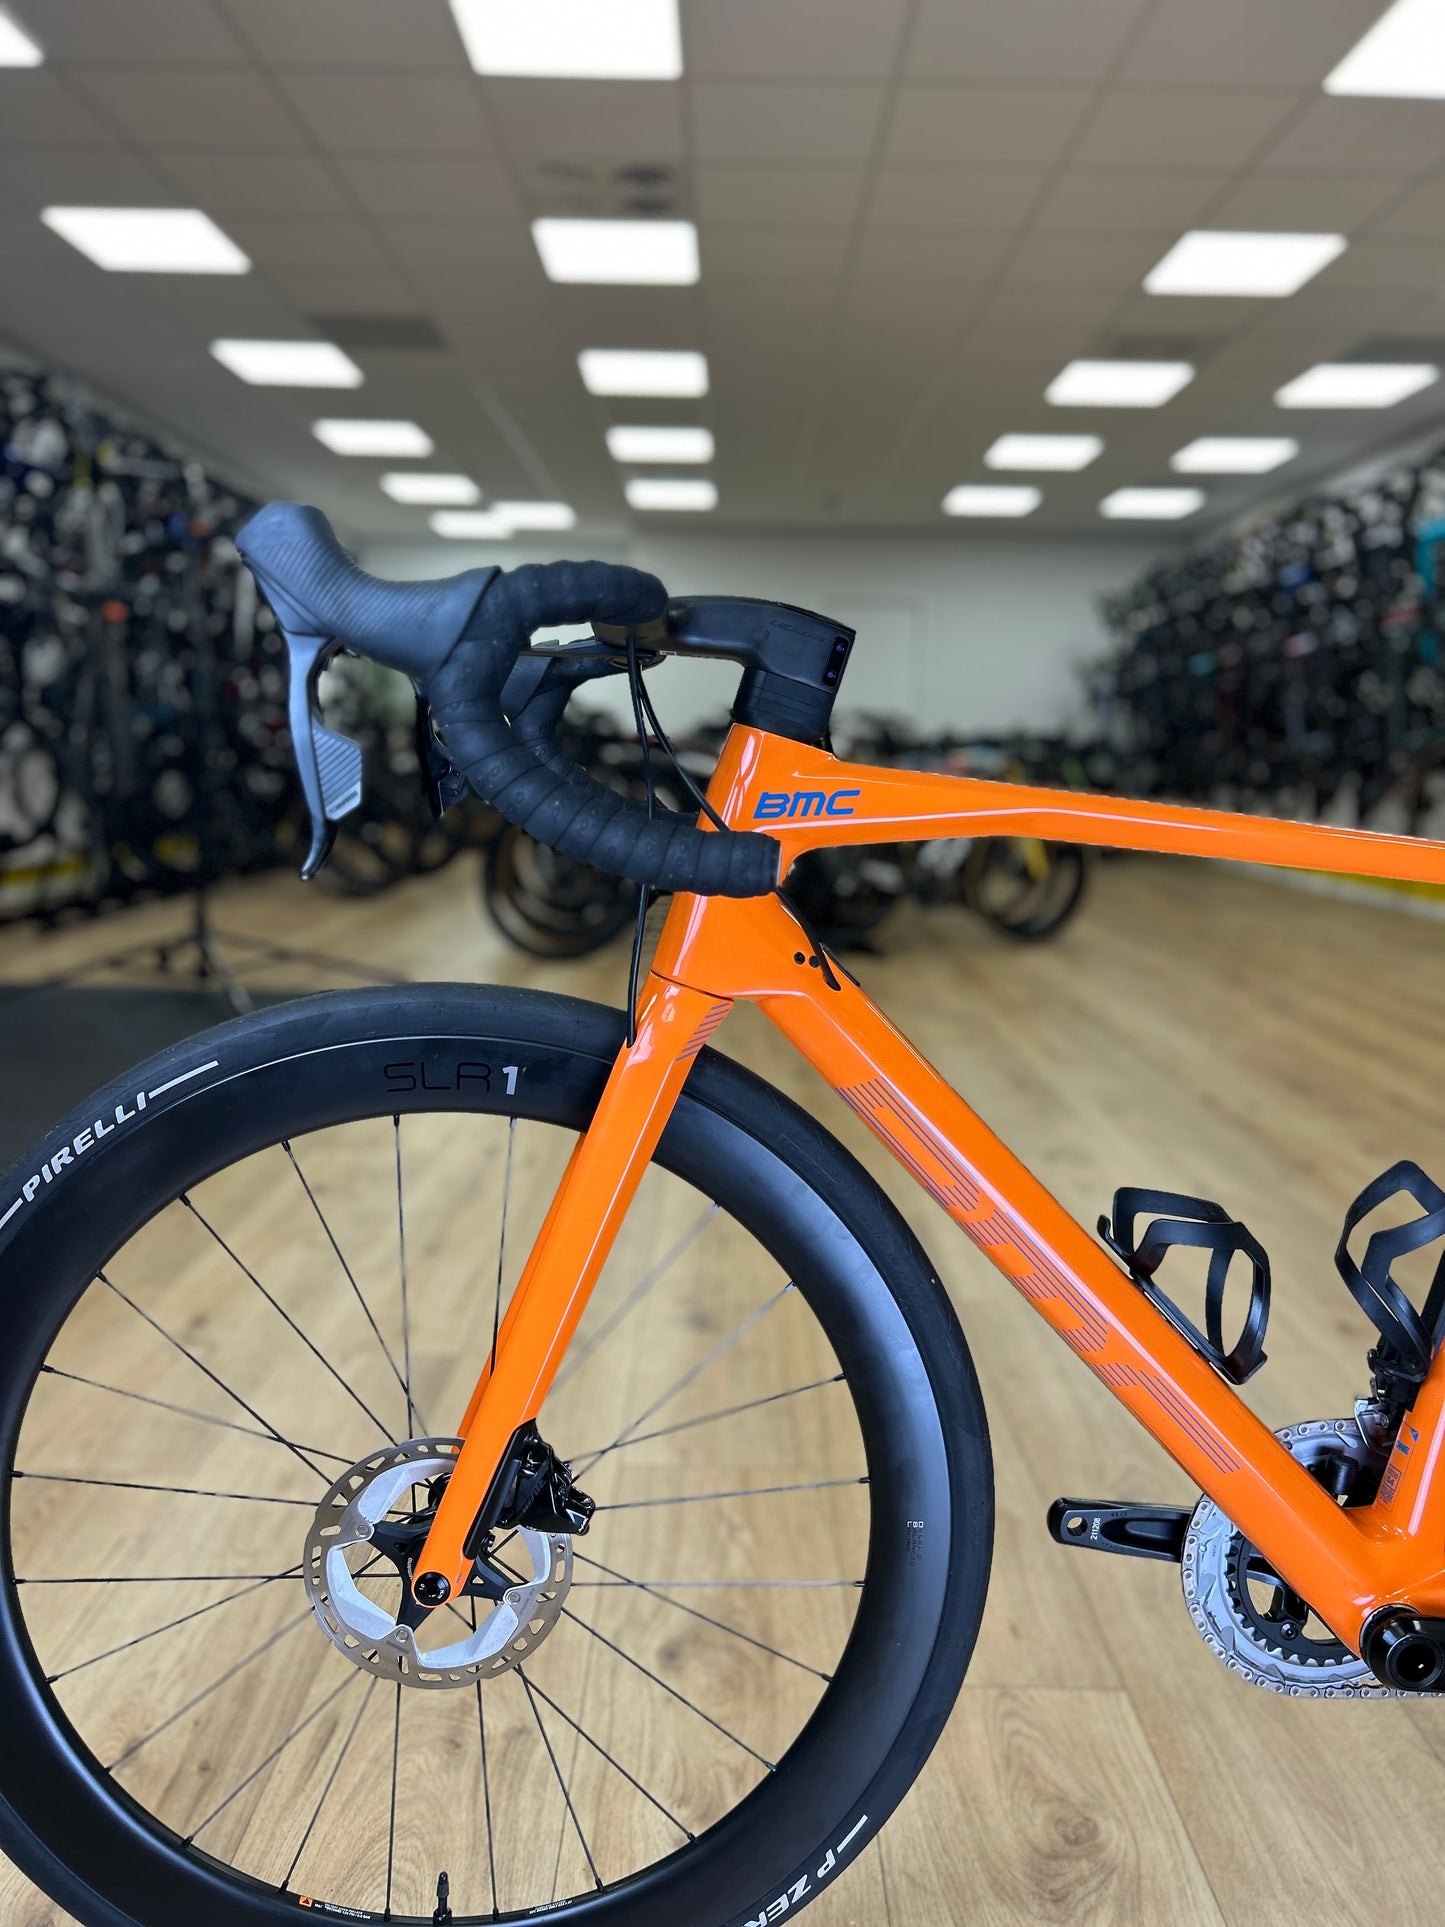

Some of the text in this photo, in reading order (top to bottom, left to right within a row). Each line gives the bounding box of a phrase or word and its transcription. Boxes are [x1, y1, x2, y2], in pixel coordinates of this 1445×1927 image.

[753, 789, 861, 819] BMC
[383, 1061, 519, 1095] SLR 1
[22, 1091, 147, 1202] PIRELLI
[816, 1849, 836, 1878] P
